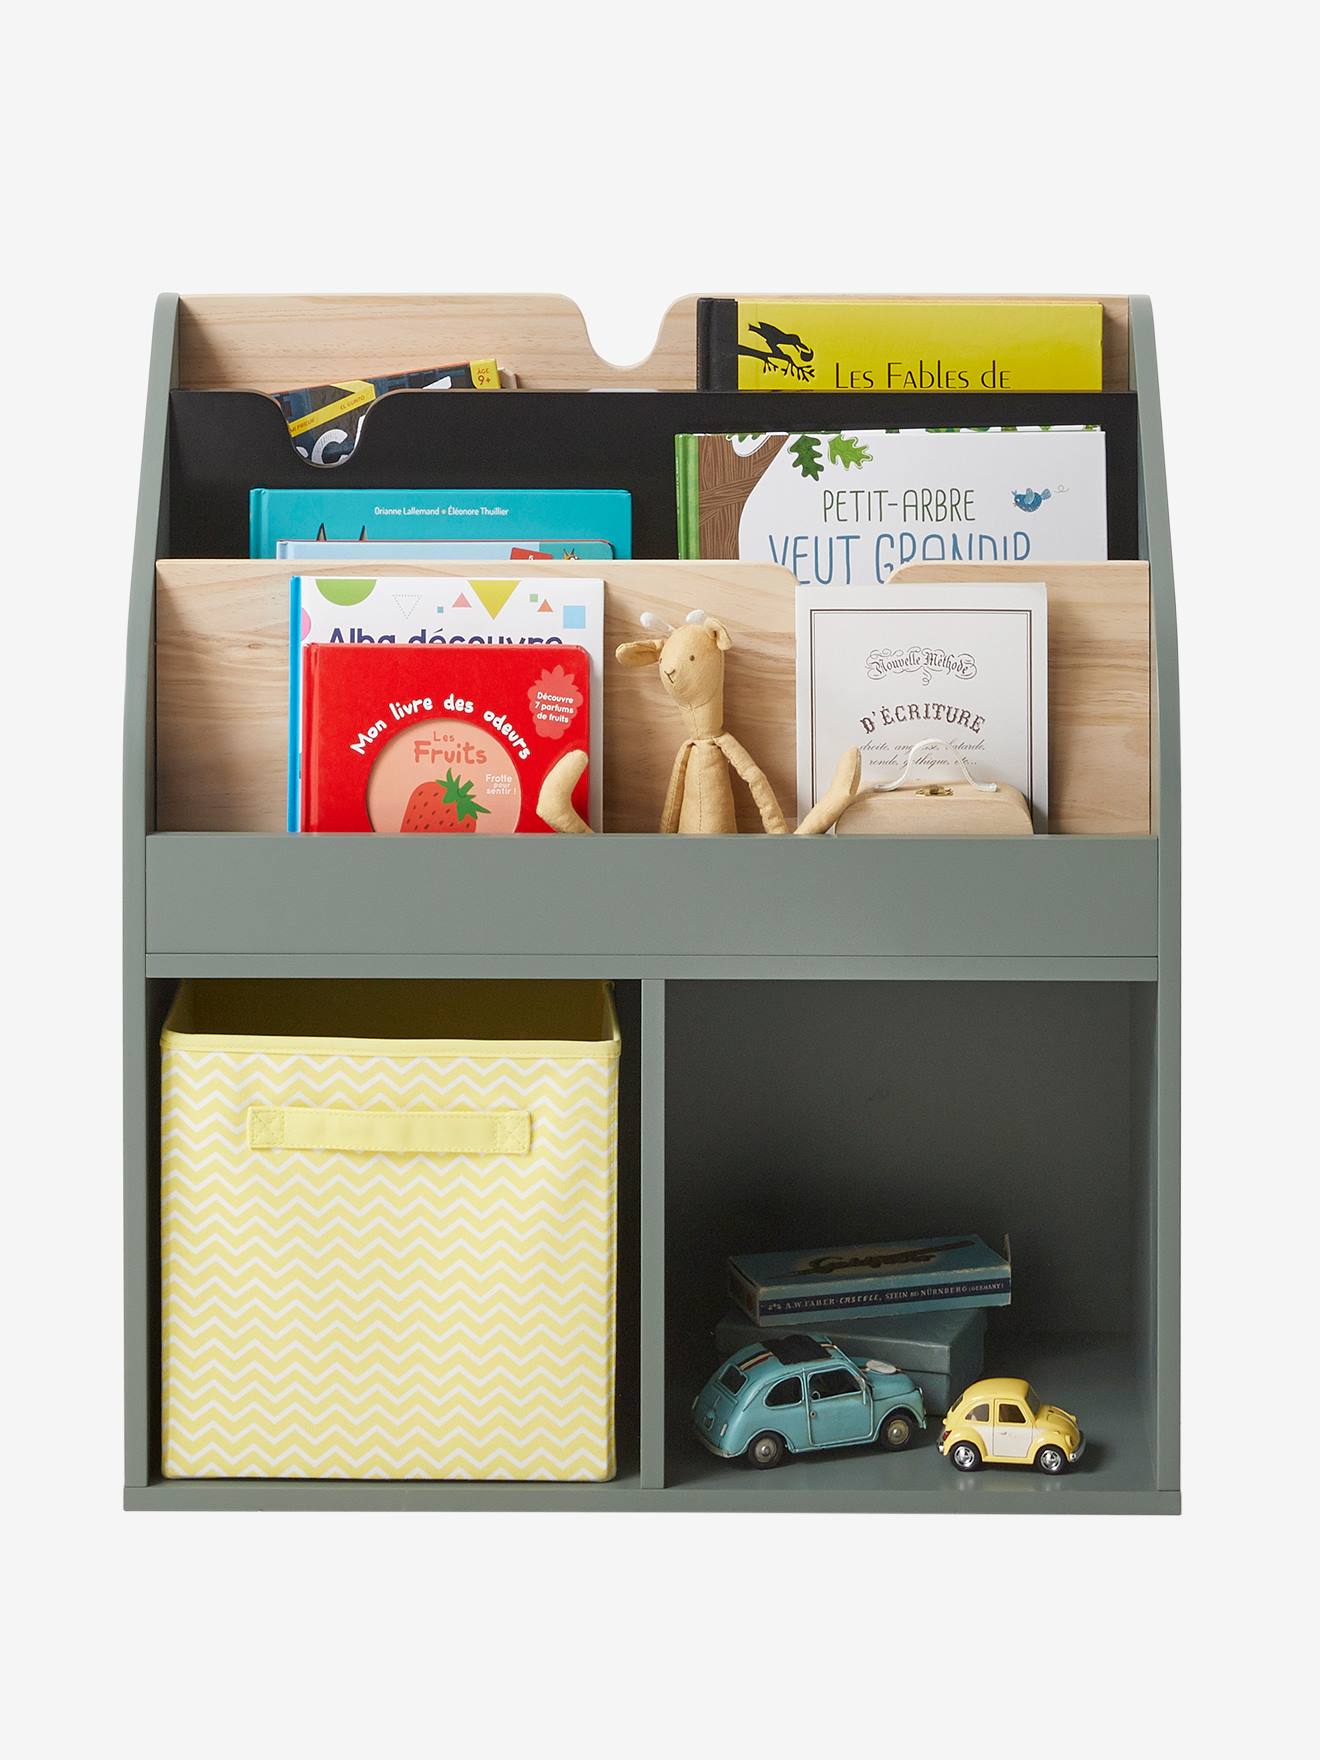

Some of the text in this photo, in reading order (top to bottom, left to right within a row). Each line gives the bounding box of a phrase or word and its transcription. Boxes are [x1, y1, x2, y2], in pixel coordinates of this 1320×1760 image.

[478, 375, 491, 386] 9+
[835, 360, 1011, 389] Les Fables de
[374, 505, 510, 516] Orianne Lallemand Éléonore Thuillier
[823, 488, 976, 523] PETIT-ARBRE
[769, 534, 861, 584] VEUT
[867, 647, 921, 677] Nouvelle
[536, 691, 574, 704] Découvre
[535, 701, 574, 714] 7 parfums
[350, 693, 531, 760] Mon livre des odeurs
[536, 712, 569, 724] de fruits
[860, 702, 986, 734] D'ÉCRITURE
[433, 731, 455, 742] Les
[414, 740, 488, 765] Fruits
[485, 773, 513, 783] Frotte
